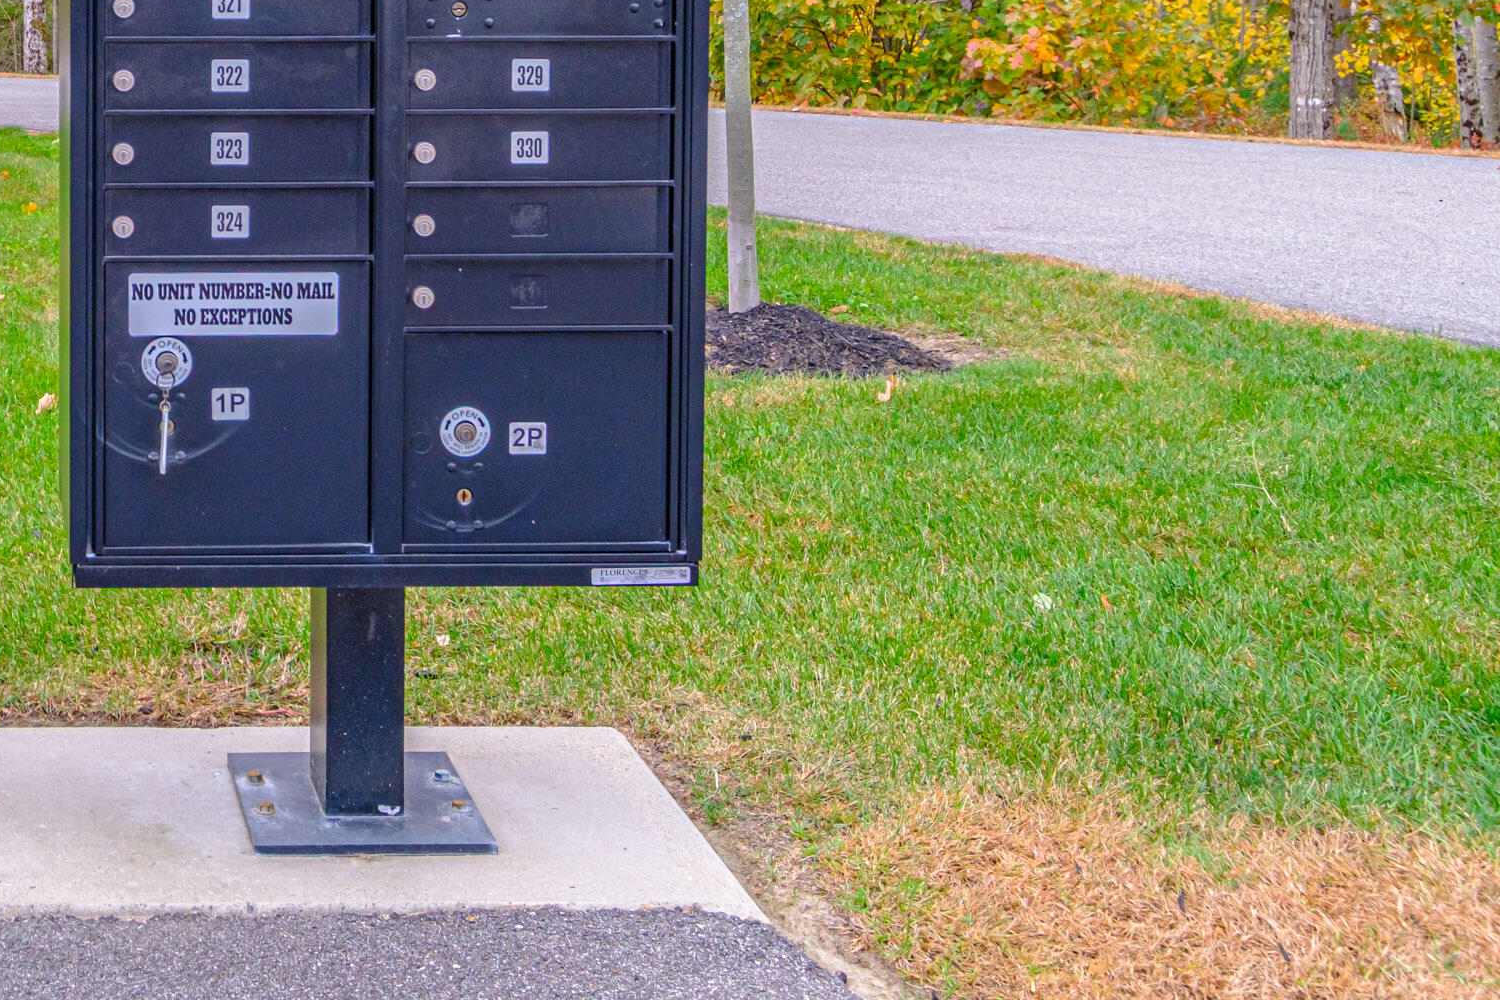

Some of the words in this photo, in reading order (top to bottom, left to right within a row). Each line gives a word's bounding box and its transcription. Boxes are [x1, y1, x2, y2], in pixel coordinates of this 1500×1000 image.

[216, 65, 243, 87] 322
[517, 65, 543, 86] 329
[216, 138, 242, 160] 323
[516, 137, 542, 158] 330
[216, 211, 243, 232] 324
[131, 283, 154, 301] NO
[157, 283, 195, 300] UNIT
[296, 282, 335, 300] MAIL
[174, 308, 196, 326] NO
[200, 308, 293, 326] EXCEPTIONS
[158, 340, 184, 353] OPEN
[215, 393, 246, 413] 1P
[451, 410, 478, 420] OPEN
[512, 427, 543, 447] 2P
